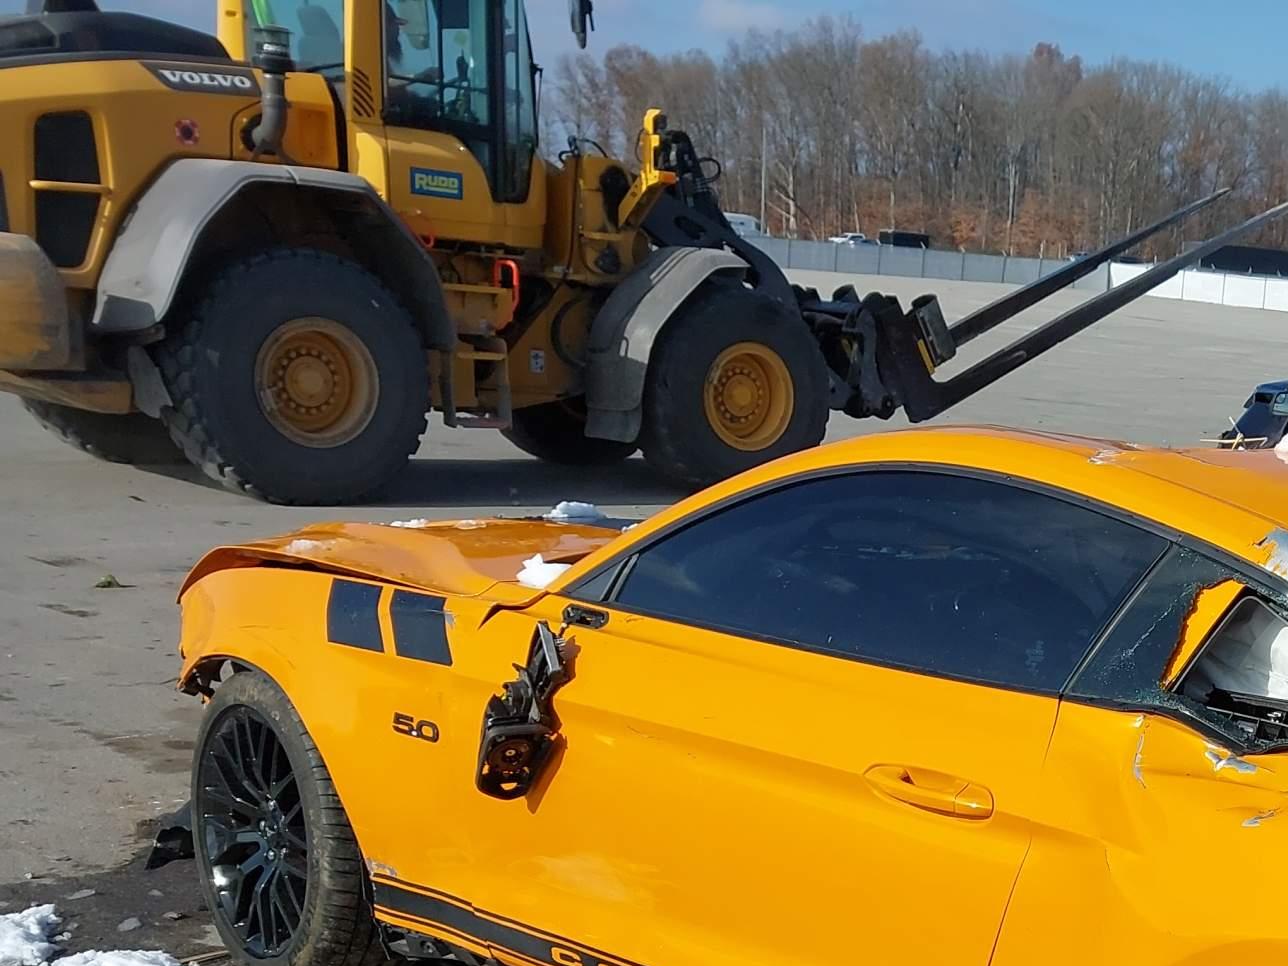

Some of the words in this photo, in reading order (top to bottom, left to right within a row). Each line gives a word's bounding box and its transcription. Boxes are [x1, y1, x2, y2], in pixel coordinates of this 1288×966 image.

[158, 69, 251, 88] VOLVO
[415, 172, 458, 193] RUDD
[392, 711, 440, 743] 5.0
